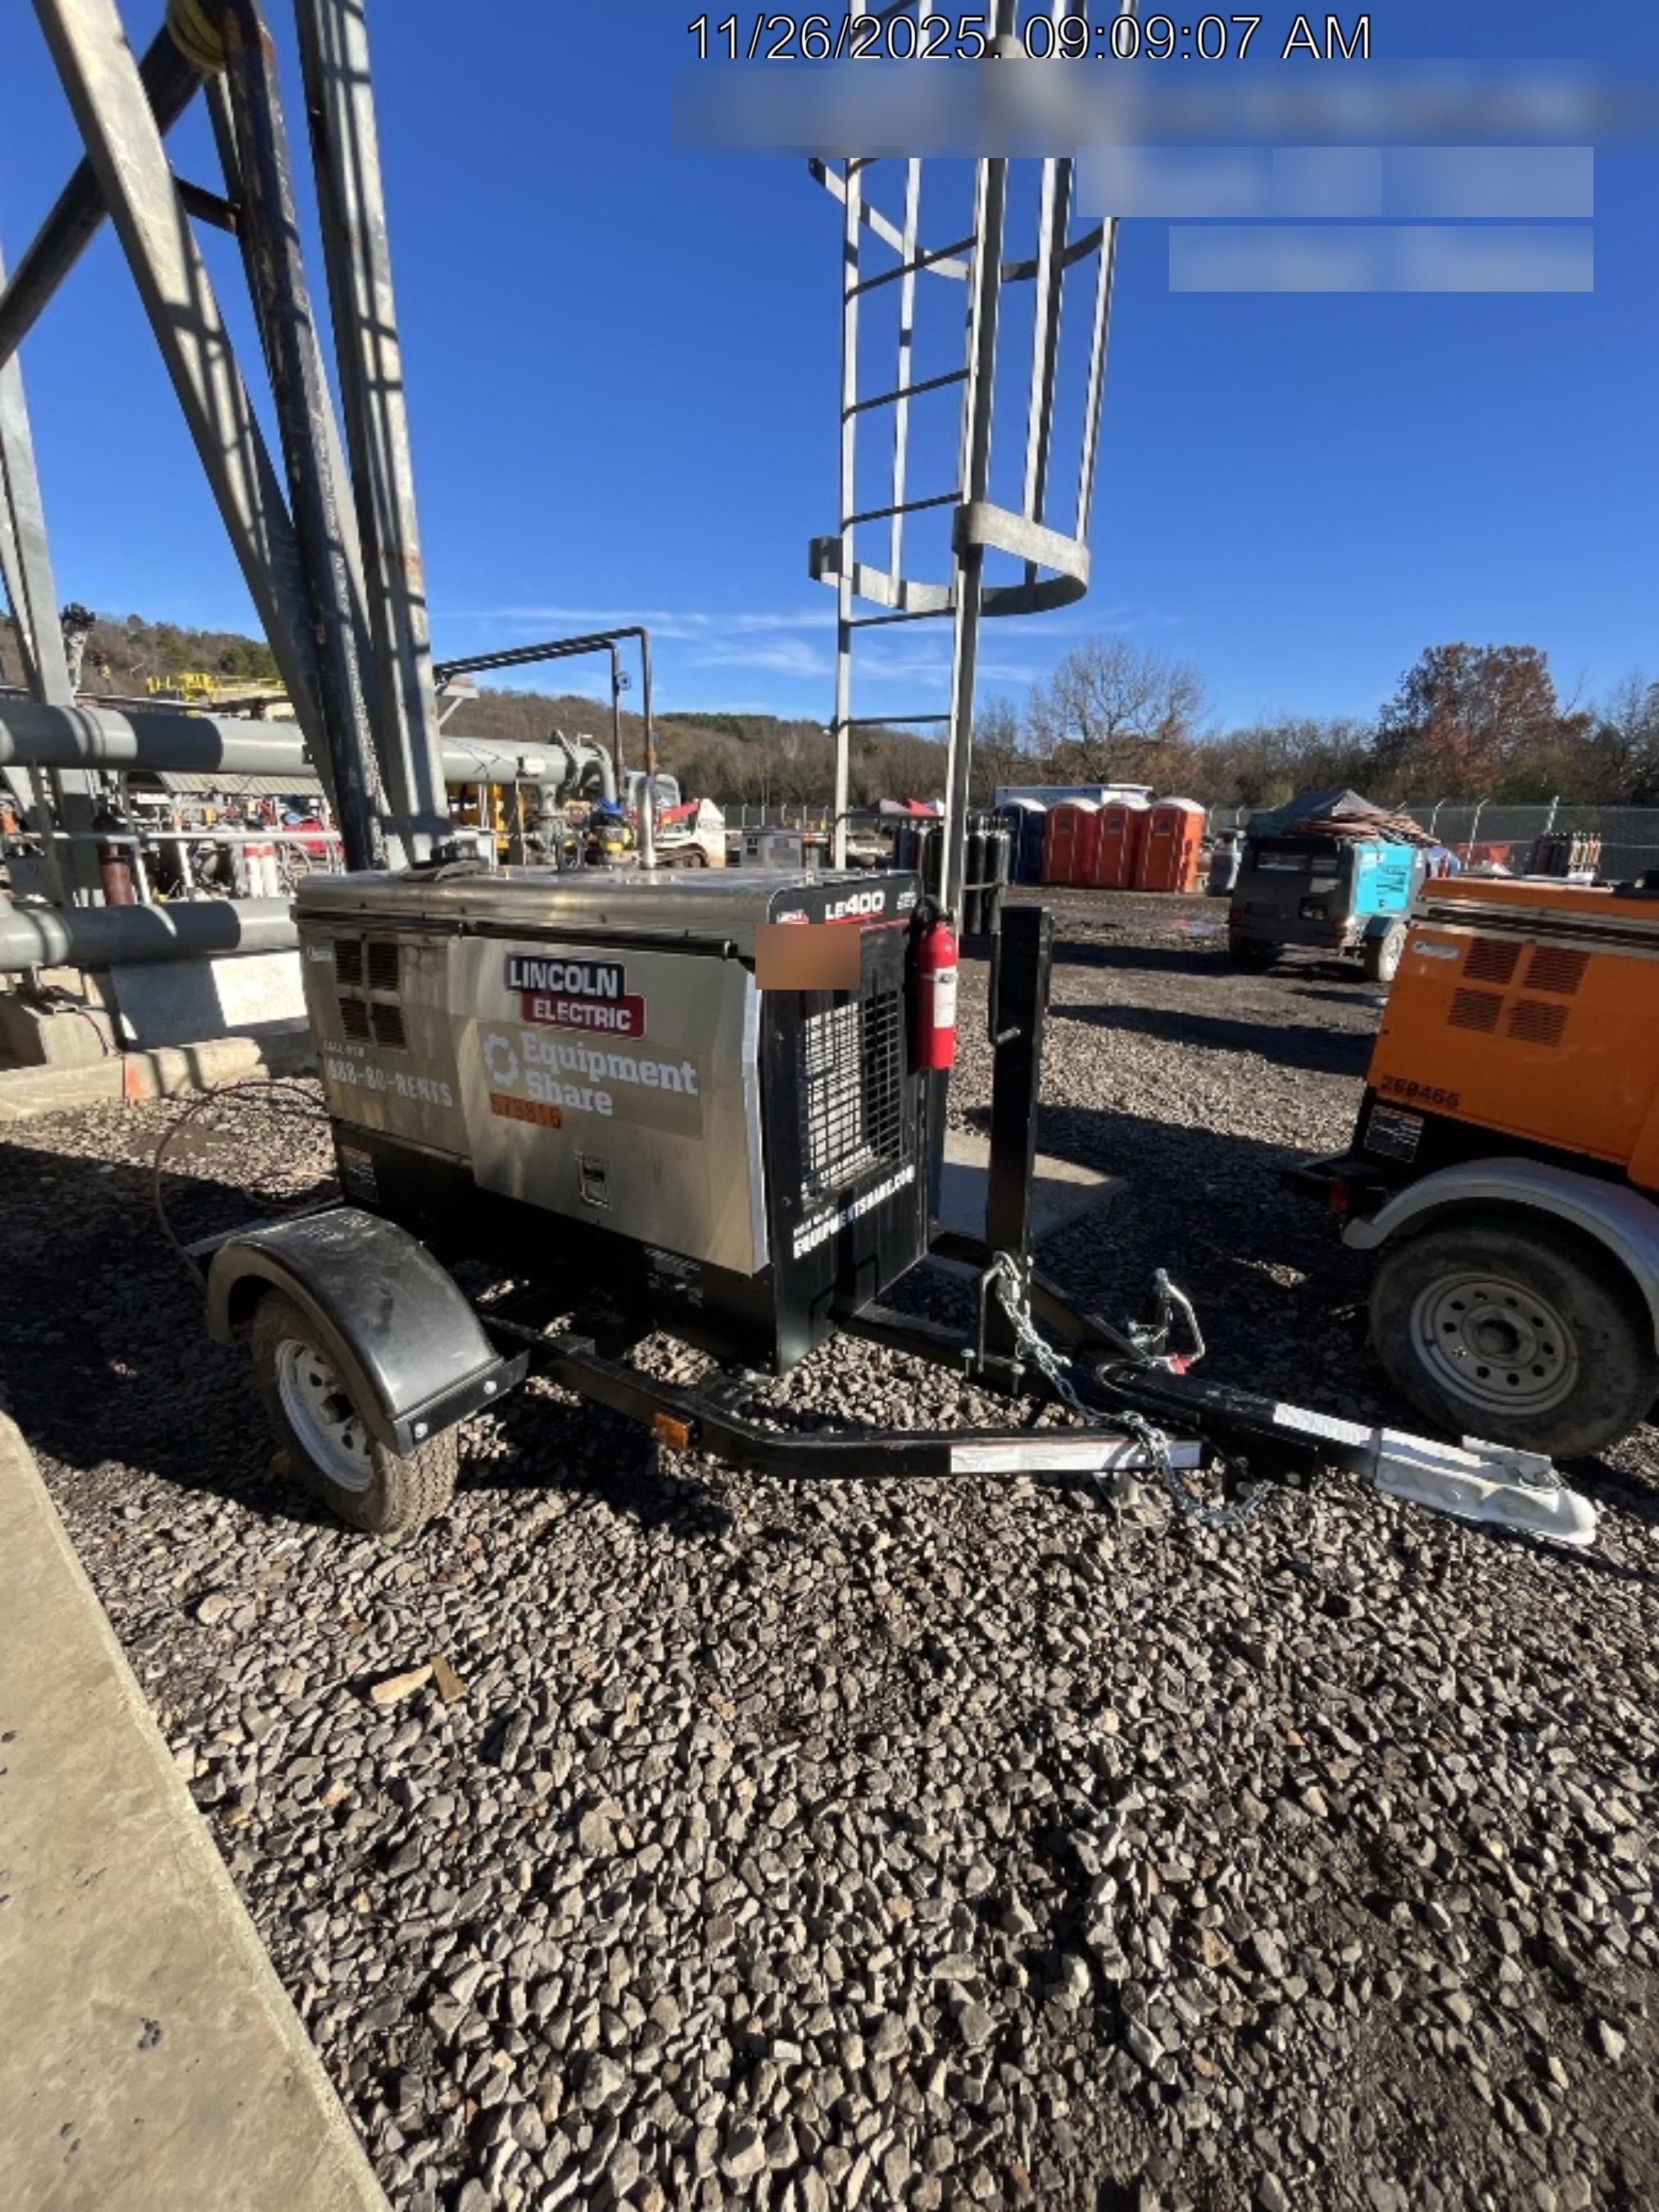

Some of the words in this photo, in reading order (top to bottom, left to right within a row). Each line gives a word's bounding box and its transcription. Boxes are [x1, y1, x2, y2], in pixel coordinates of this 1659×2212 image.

[510, 959, 618, 999] LINCOLN
[533, 999, 632, 1031] ELECTRIC
[519, 1031, 698, 1095] Equipment
[524, 1070, 614, 1117] Share
